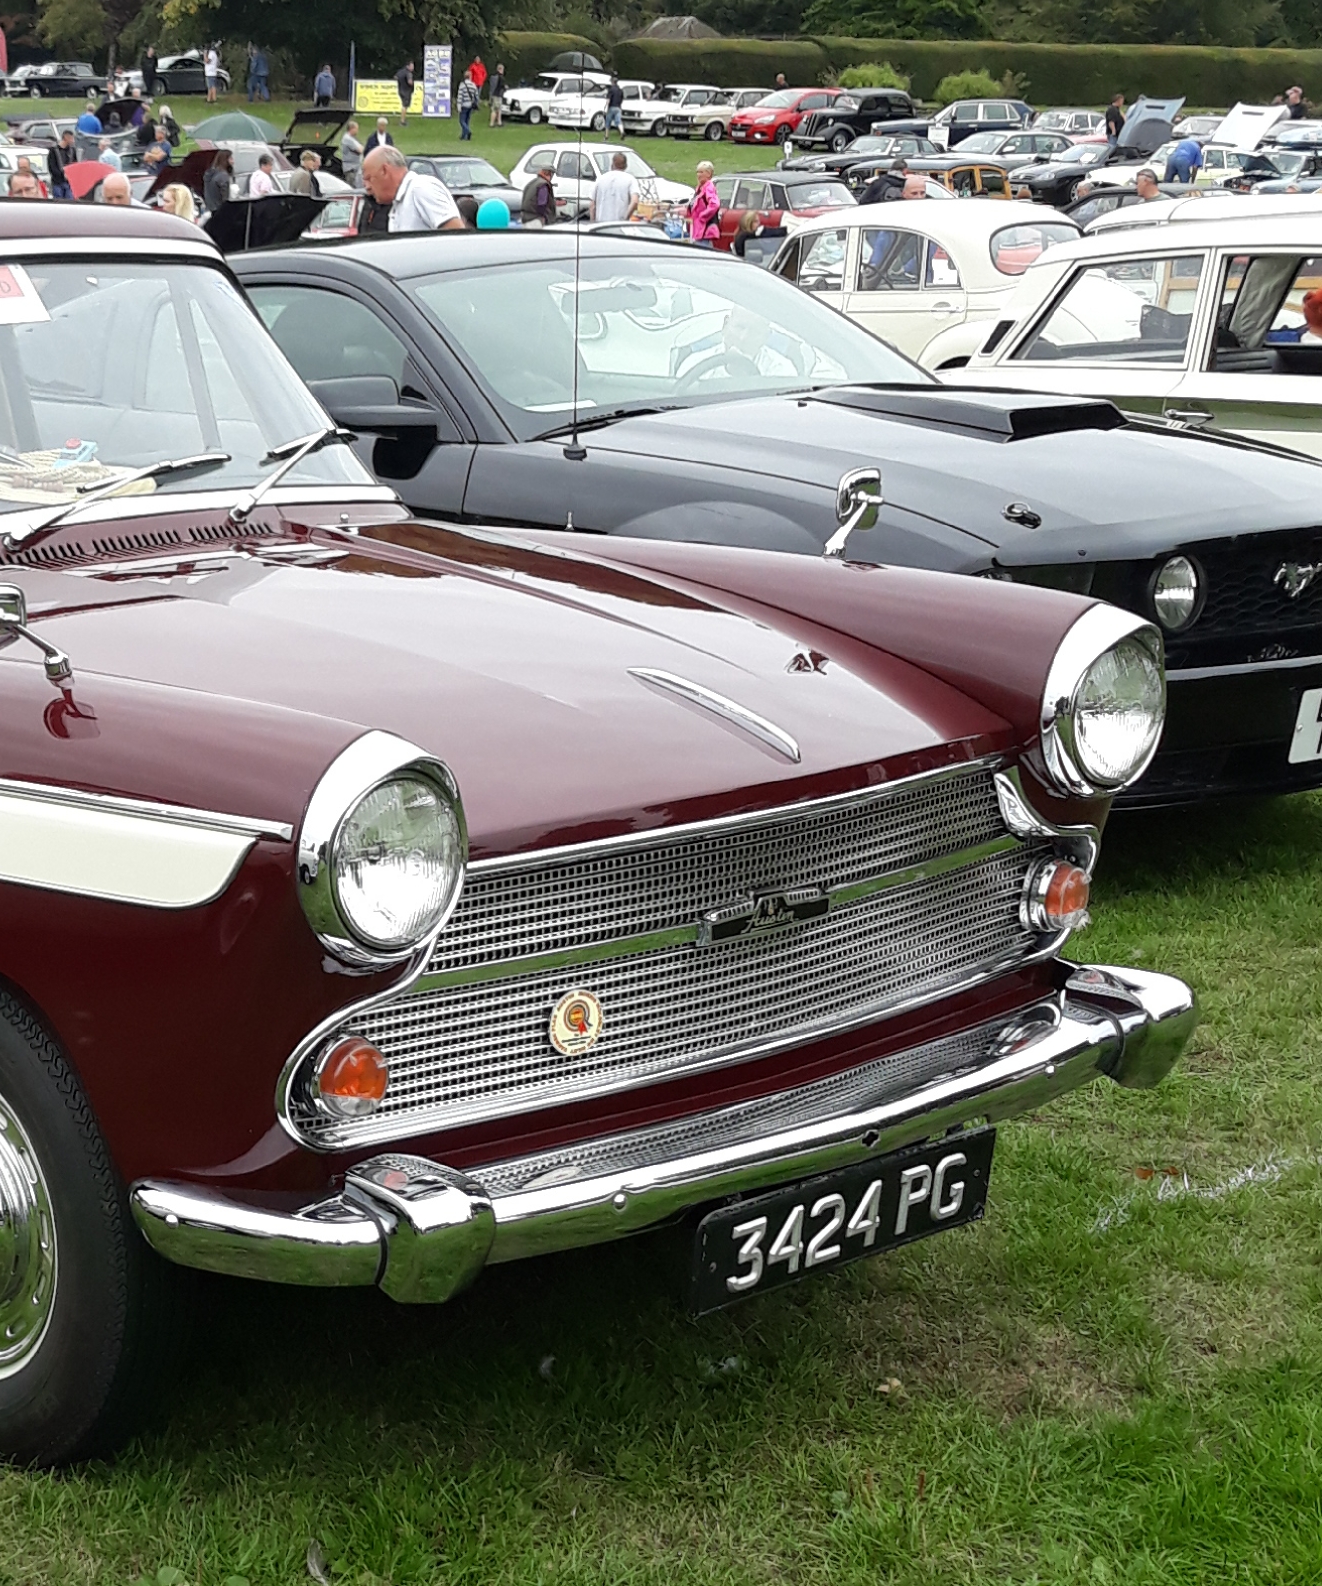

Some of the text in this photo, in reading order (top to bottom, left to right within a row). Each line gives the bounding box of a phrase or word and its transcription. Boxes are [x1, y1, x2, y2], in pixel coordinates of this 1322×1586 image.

[741, 908, 797, 934] Austin
[727, 1152, 967, 1293] 3424 PG
